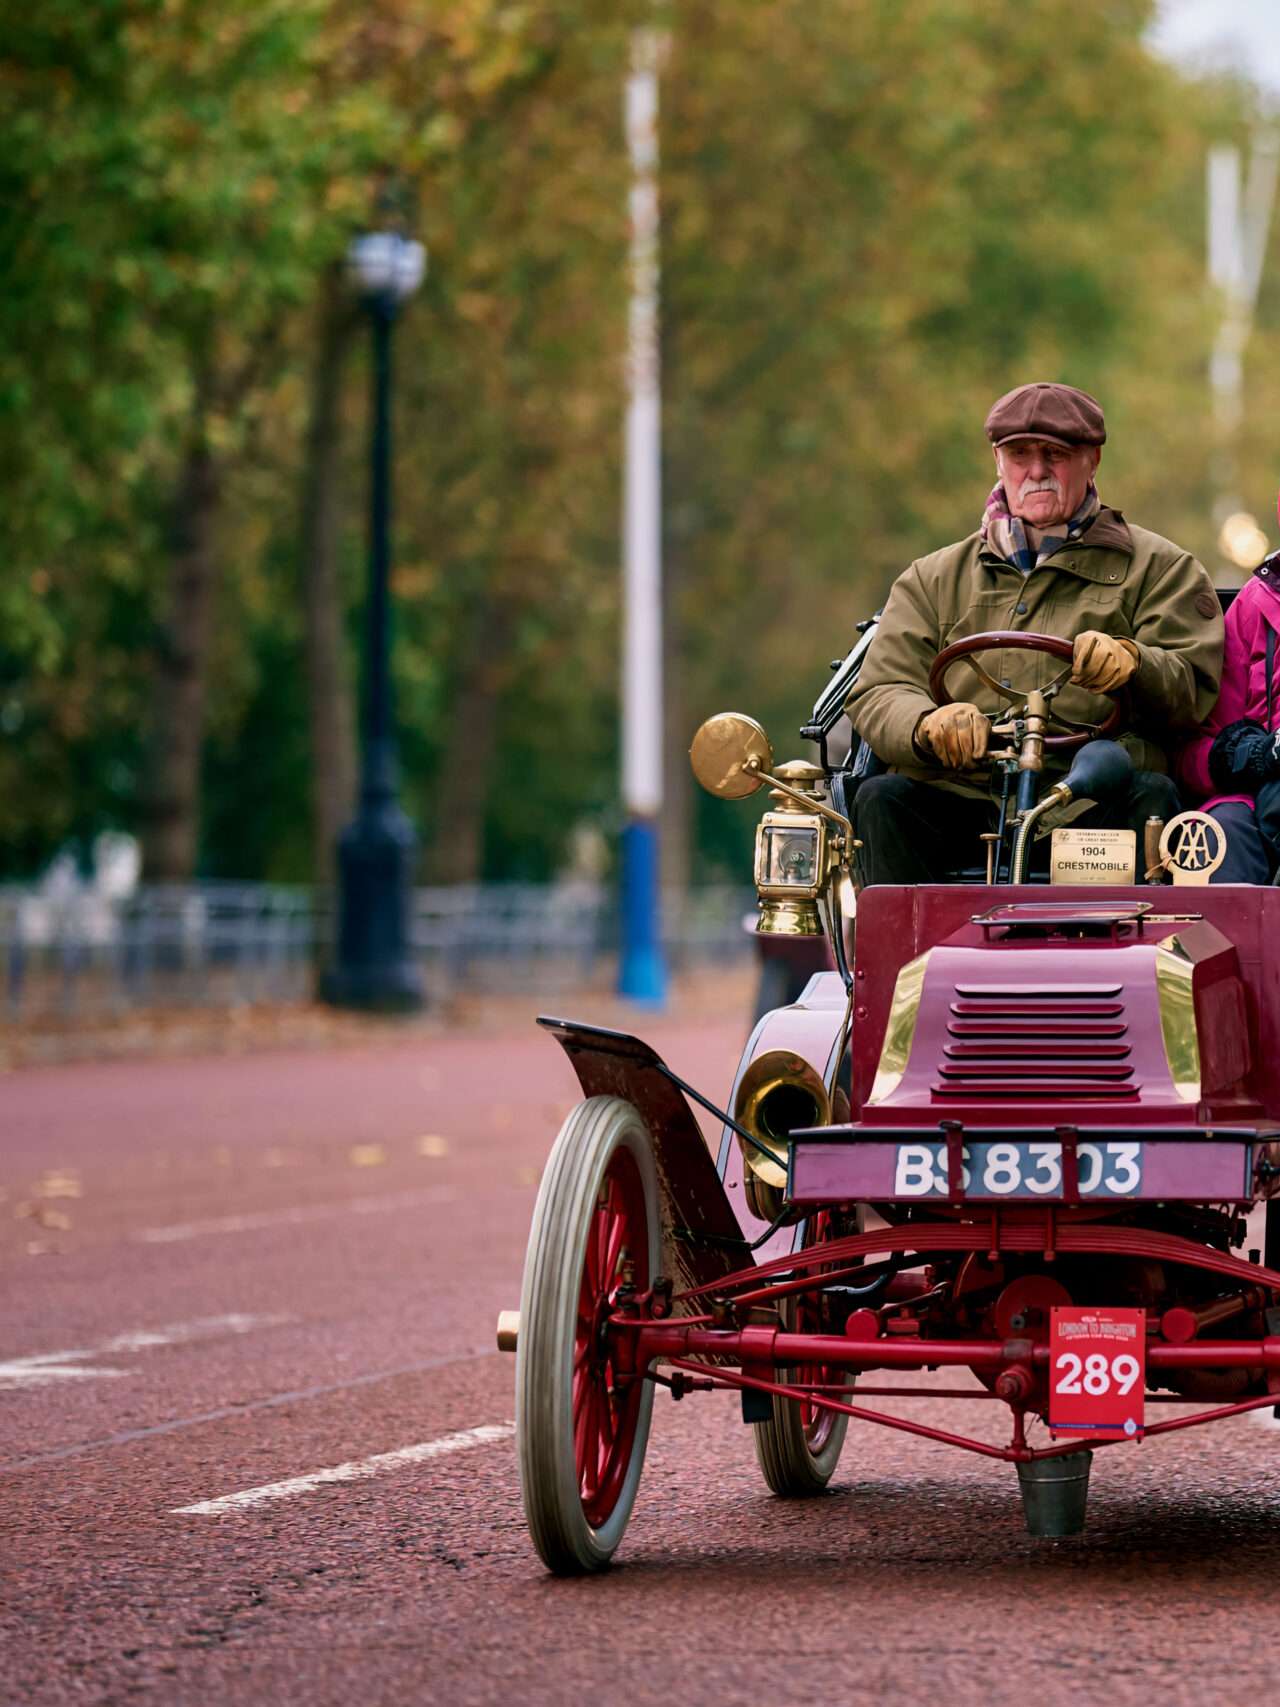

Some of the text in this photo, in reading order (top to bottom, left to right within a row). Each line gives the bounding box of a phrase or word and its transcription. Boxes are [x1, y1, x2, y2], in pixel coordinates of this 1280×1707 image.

[1081, 847, 1106, 856] 1904
[1057, 861, 1129, 871] CRESTMOBILE
[895, 1142, 1142, 1196] BS 8303
[1056, 1352, 1140, 1396] 289
